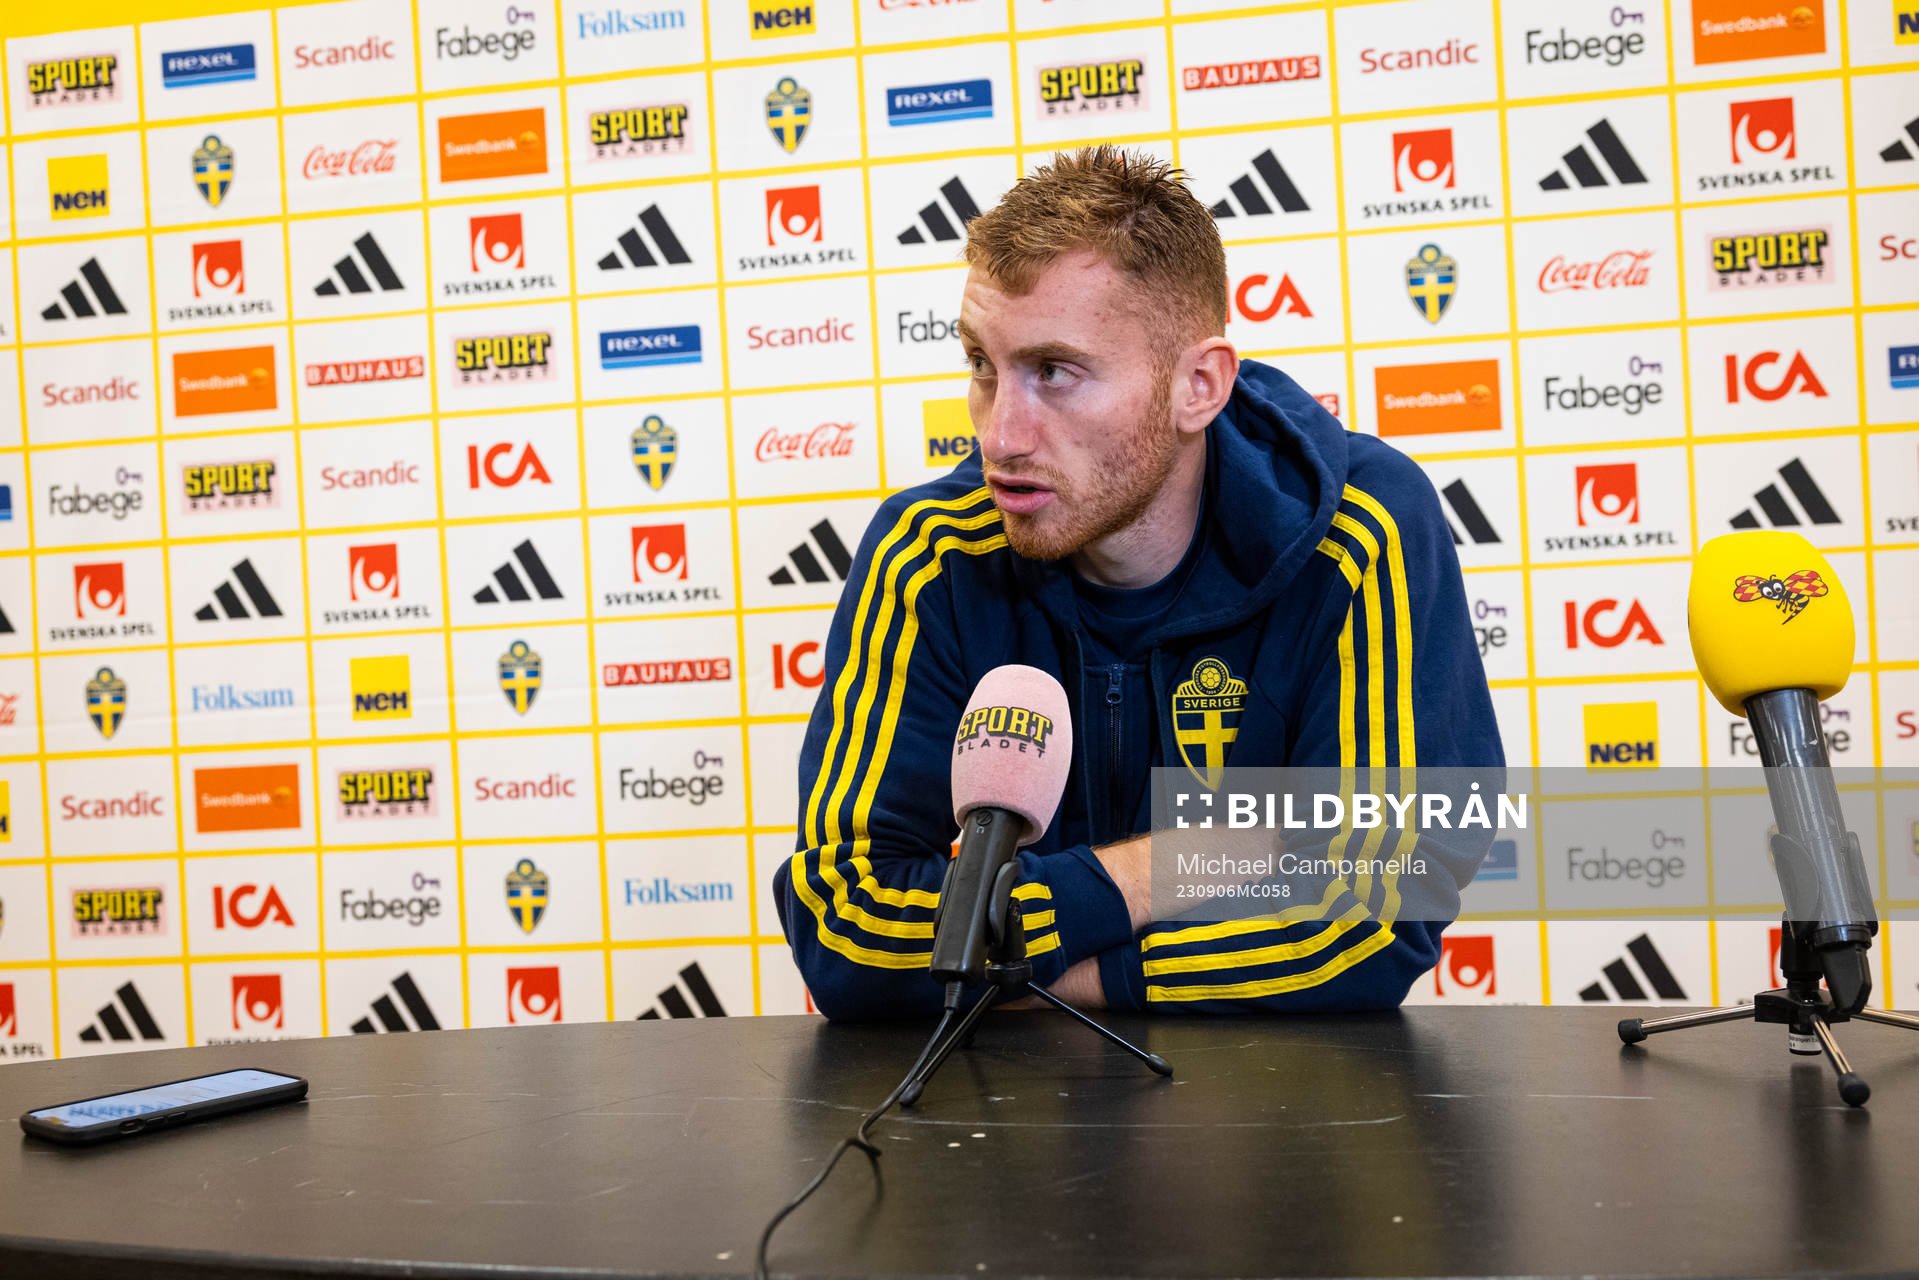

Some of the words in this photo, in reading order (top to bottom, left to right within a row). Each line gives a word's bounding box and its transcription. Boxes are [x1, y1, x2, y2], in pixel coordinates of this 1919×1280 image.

[579, 10, 685, 39] Folksam
[1700, 13, 1788, 36] Swedbank
[294, 36, 394, 69] Scandic
[436, 26, 535, 61] Fabege
[1360, 39, 1478, 73] Scandic
[1526, 28, 1644, 66] Fabege
[28, 56, 117, 94] SPORT
[1040, 60, 1143, 103] SPORT
[1184, 56, 1320, 90] BAUHAUS
[590, 105, 688, 145] SPORT
[444, 137, 516, 158] Swedbank
[1699, 171, 1783, 190] SVENSKA
[1790, 167, 1834, 182] SPEL
[1364, 200, 1443, 218] SVENSKA
[1451, 196, 1490, 210] SPEL
[739, 253, 812, 270] SVENSKA
[818, 249, 854, 263] SPEL
[1712, 230, 1828, 274] SPORT
[444, 280, 514, 295] SVENSKA
[521, 276, 555, 289] SPEL
[169, 304, 234, 320] SVENSKA
[241, 301, 273, 314] SPEL
[898, 309, 960, 344] Fabe
[747, 318, 854, 349] Scandic
[456, 333, 551, 371] SPORT
[179, 374, 248, 392] Swedbank
[305, 356, 424, 388] BAUHAUS
[1725, 351, 1828, 404] ICA
[42, 378, 138, 407] Scandic
[1384, 391, 1466, 410] Swedbank
[1545, 376, 1662, 415] Fabege
[184, 460, 275, 498] SPORT
[321, 461, 418, 491] Scandic
[468, 442, 552, 489] ICA
[49, 485, 142, 520] Fabege
[1545, 535, 1627, 551] SVENSKA
[1634, 532, 1675, 546] SPEL
[605, 591, 677, 605] SVENSKA
[684, 588, 720, 601] SPEL
[324, 609, 389, 624] SVENSKA
[395, 606, 429, 618] SPEL
[1565, 598, 1664, 649] ICA
[50, 626, 116, 640] SVENSKA
[122, 624, 153, 636] SPEL
[604, 658, 730, 687] BAUHAUS
[773, 641, 826, 689] IC
[192, 685, 294, 712] Folksam
[1183, 697, 1240, 709] SVERIGE
[957, 706, 1053, 749] SPORT
[958, 738, 1045, 758] BLADET
[339, 768, 432, 806] SPORT
[475, 774, 575, 801] Scandic
[620, 768, 724, 806] Fabege
[61, 792, 163, 820] Scandic
[1568, 846, 1685, 888] Fabege
[74, 888, 162, 923] SPORT
[213, 884, 294, 930] ICA
[341, 889, 441, 926] Fabege
[625, 878, 733, 905] Folksam
